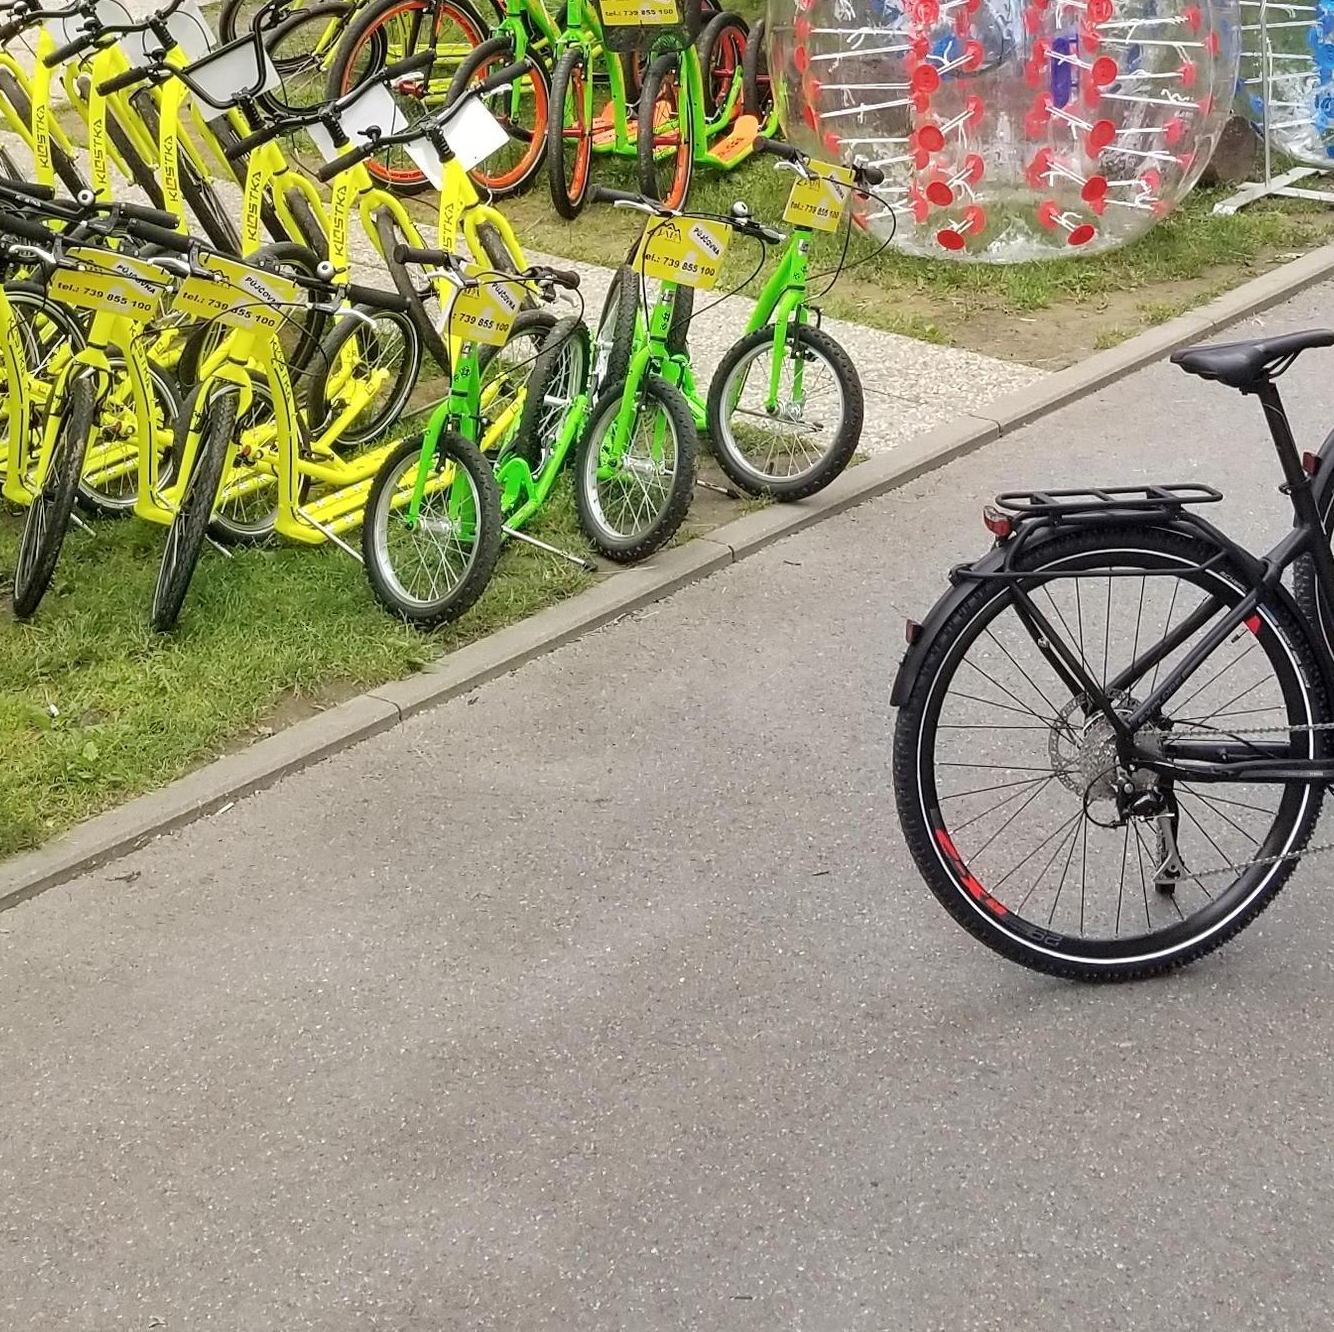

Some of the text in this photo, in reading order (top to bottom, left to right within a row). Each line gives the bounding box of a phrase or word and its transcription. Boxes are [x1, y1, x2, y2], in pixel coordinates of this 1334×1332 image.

[33, 104, 49, 168] KOSTKA
[90, 119, 106, 184] KOSTKA
[162, 135, 178, 203] KOSTKA
[248, 169, 264, 241] KOSTKA
[335, 184, 348, 256] KOSTKA
[790, 201, 805, 211] tel.:
[805, 204, 817, 214] 739
[694, 226, 720, 256] PŮJČOVNA
[663, 257, 680, 269] 739
[681, 261, 698, 273] 855
[700, 266, 716, 277] 100
[56, 280, 152, 312] tel.: 739 855 100
[182, 291, 205, 305] tel.:
[208, 297, 228, 311] 739
[254, 315, 276, 328] 100
[459, 313, 509, 332] 739 855 100
